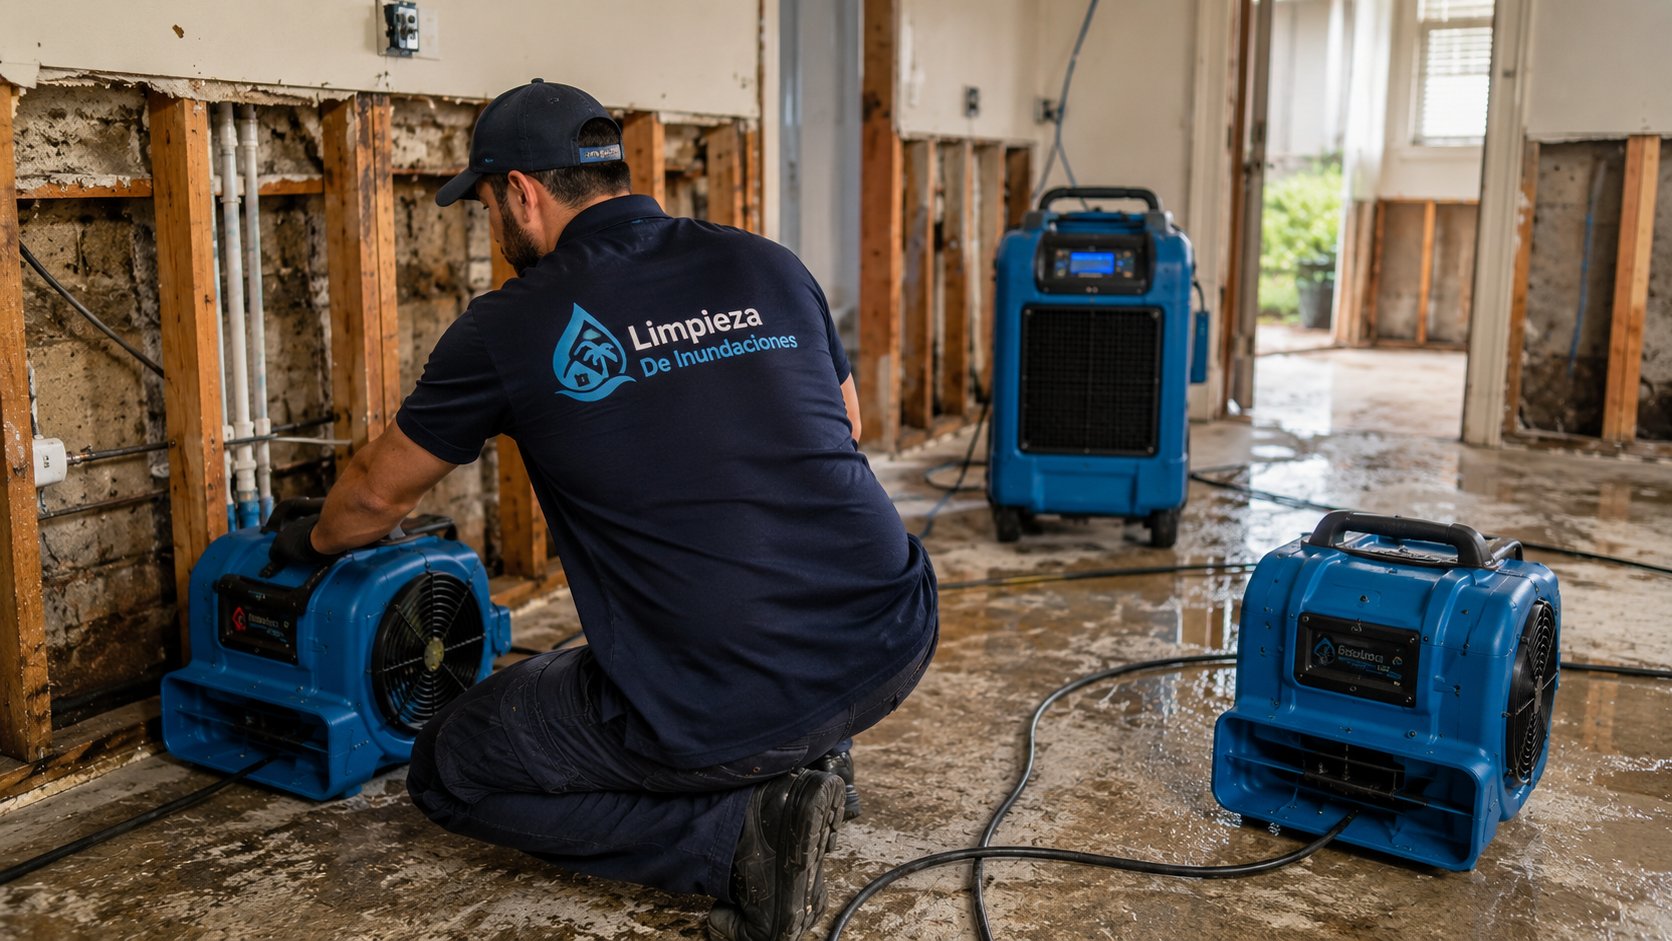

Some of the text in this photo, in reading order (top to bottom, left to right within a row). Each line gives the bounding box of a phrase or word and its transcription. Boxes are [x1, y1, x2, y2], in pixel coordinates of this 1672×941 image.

[627, 307, 764, 351] Limpieza
[639, 333, 799, 378] De Inundaciones
